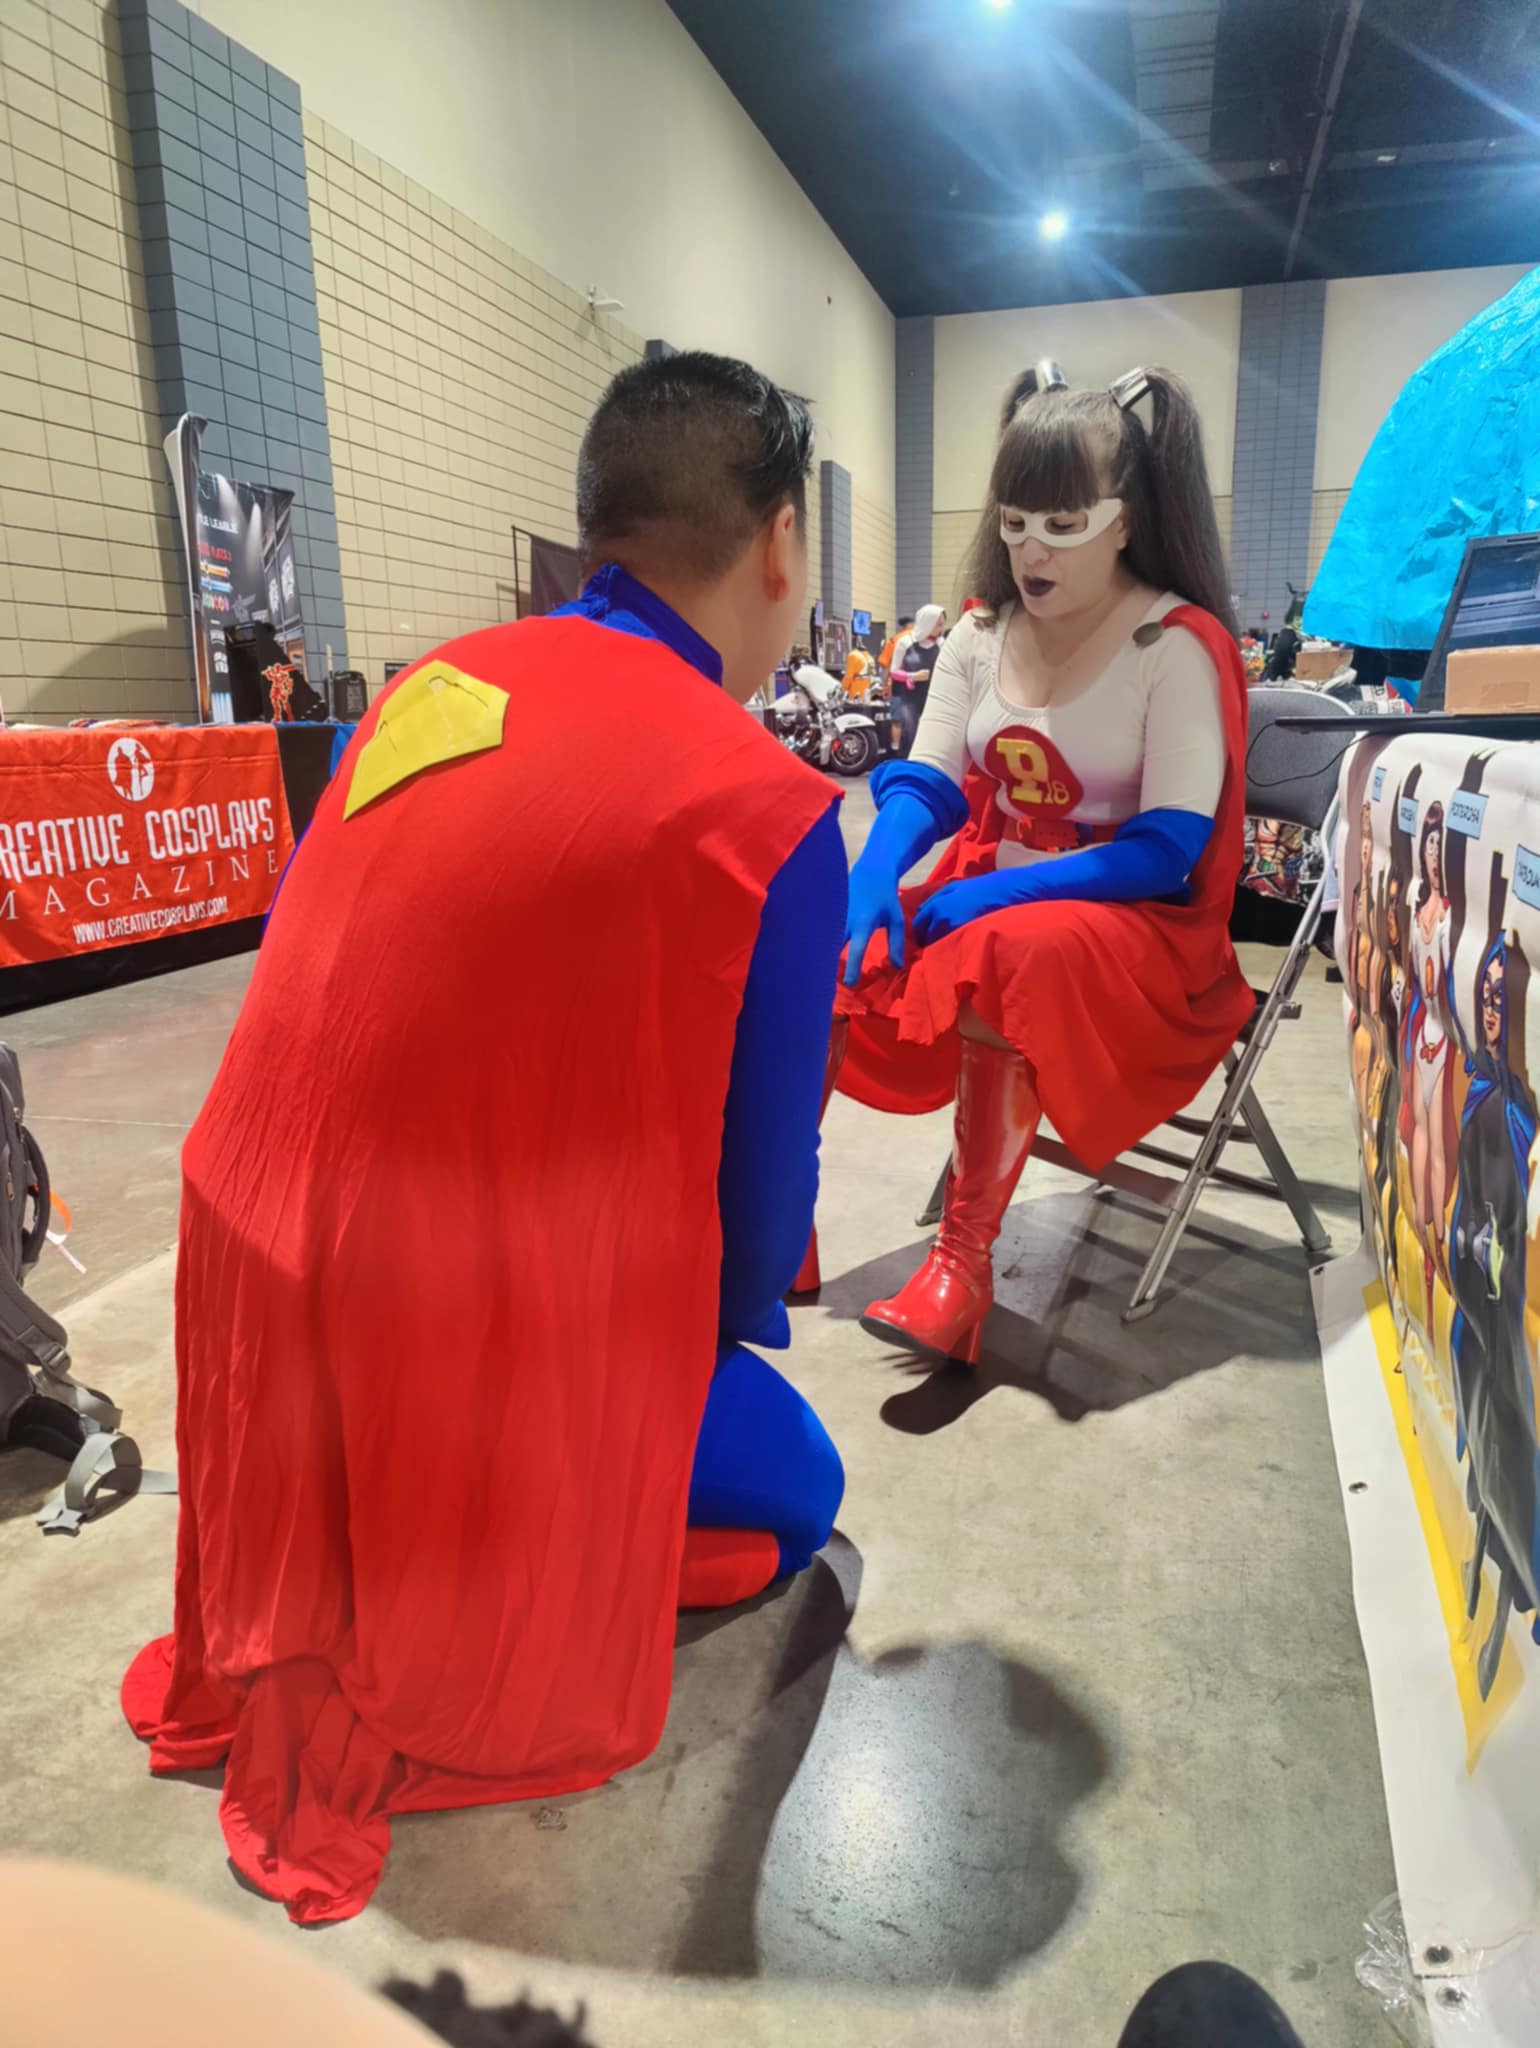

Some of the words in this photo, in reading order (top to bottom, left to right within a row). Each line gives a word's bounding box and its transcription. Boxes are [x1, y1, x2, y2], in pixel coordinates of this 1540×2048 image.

[0, 814, 130, 884] REATIVE
[145, 797, 275, 860] COSPLAYS
[72, 896, 229, 945] WWW.CREATIVECOSPLAYS.COM
